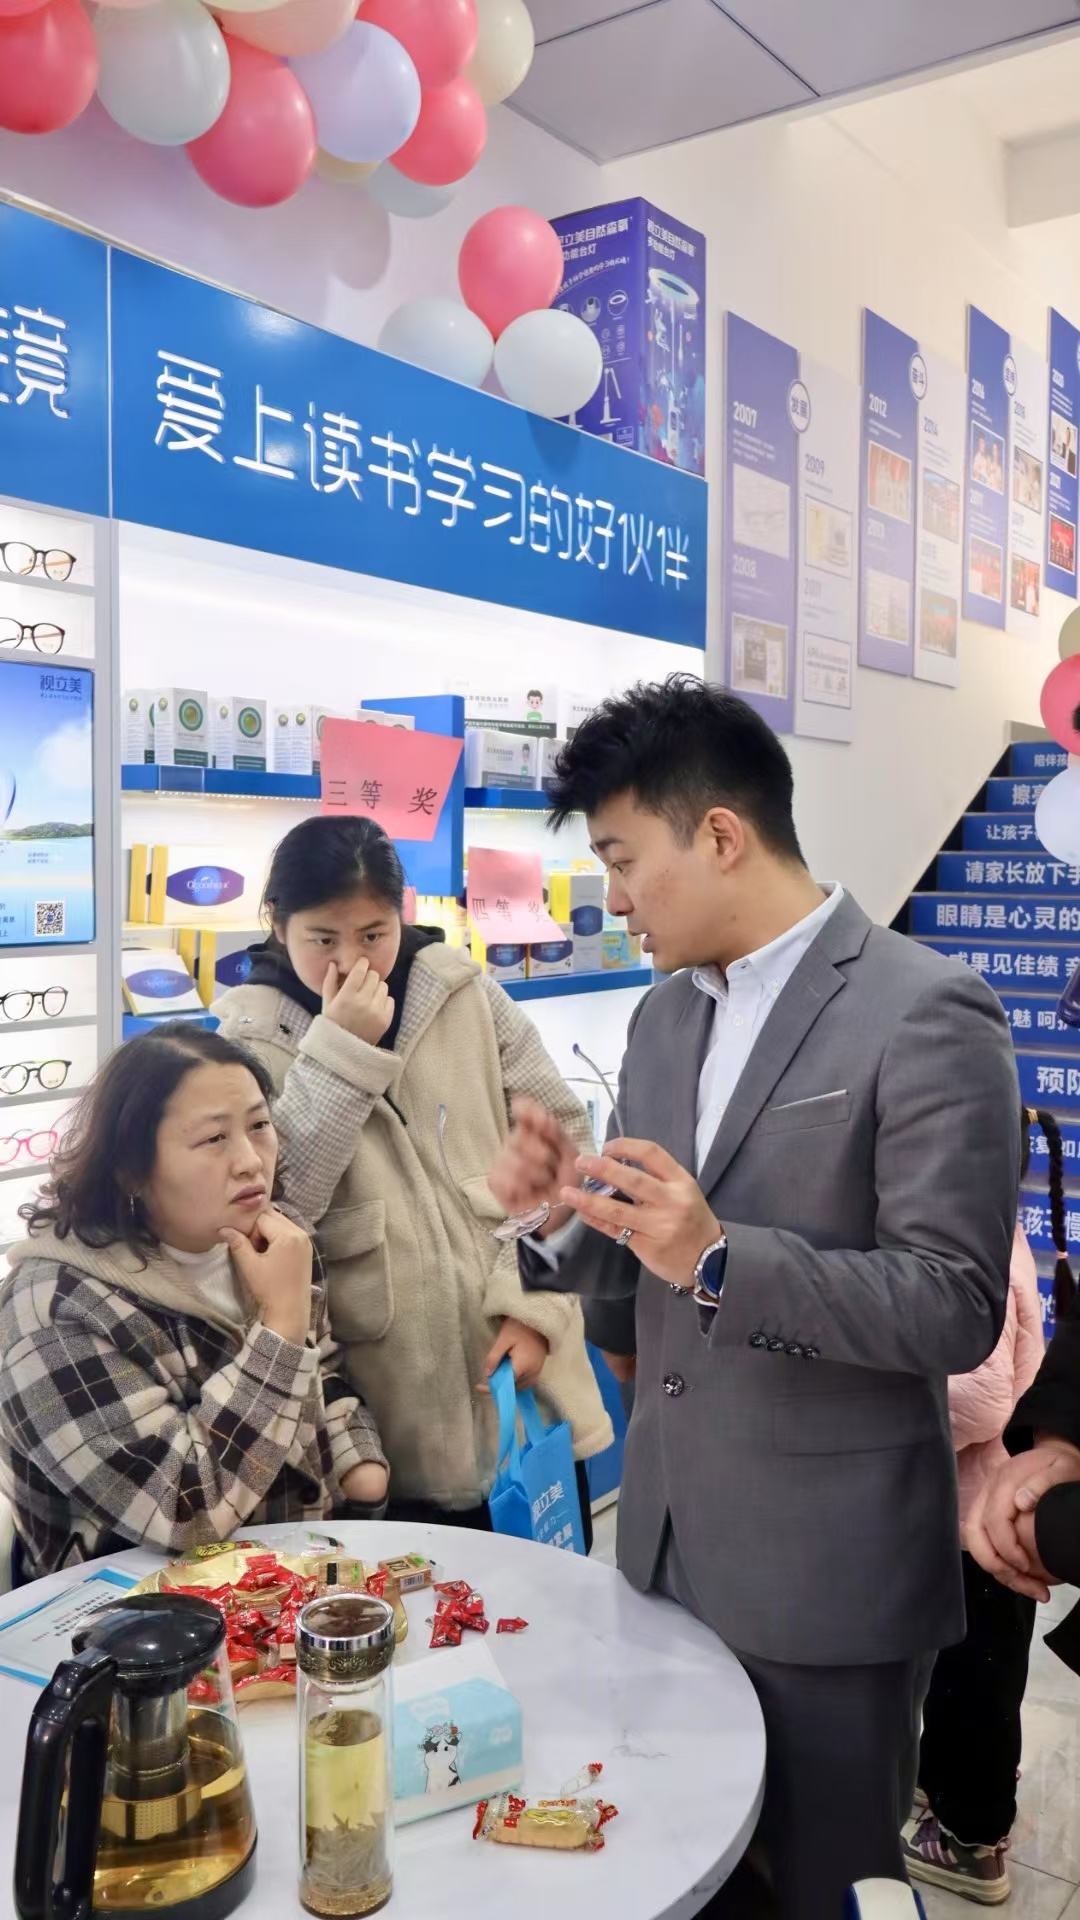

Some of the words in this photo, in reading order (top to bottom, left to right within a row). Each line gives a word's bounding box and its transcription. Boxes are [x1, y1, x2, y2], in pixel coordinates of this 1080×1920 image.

[733, 401, 757, 428] 2007
[155, 349, 690, 590] 爱上读书学习的好伙伴
[732, 554, 757, 578] 2008
[40, 675, 82, 693] 视立美
[327, 779, 438, 816] 三等奖
[986, 823, 1041, 841] 让孩子
[937, 904, 1080, 931] 眼睛是心灵的
[1005, 1008, 1031, 1028] 魅
